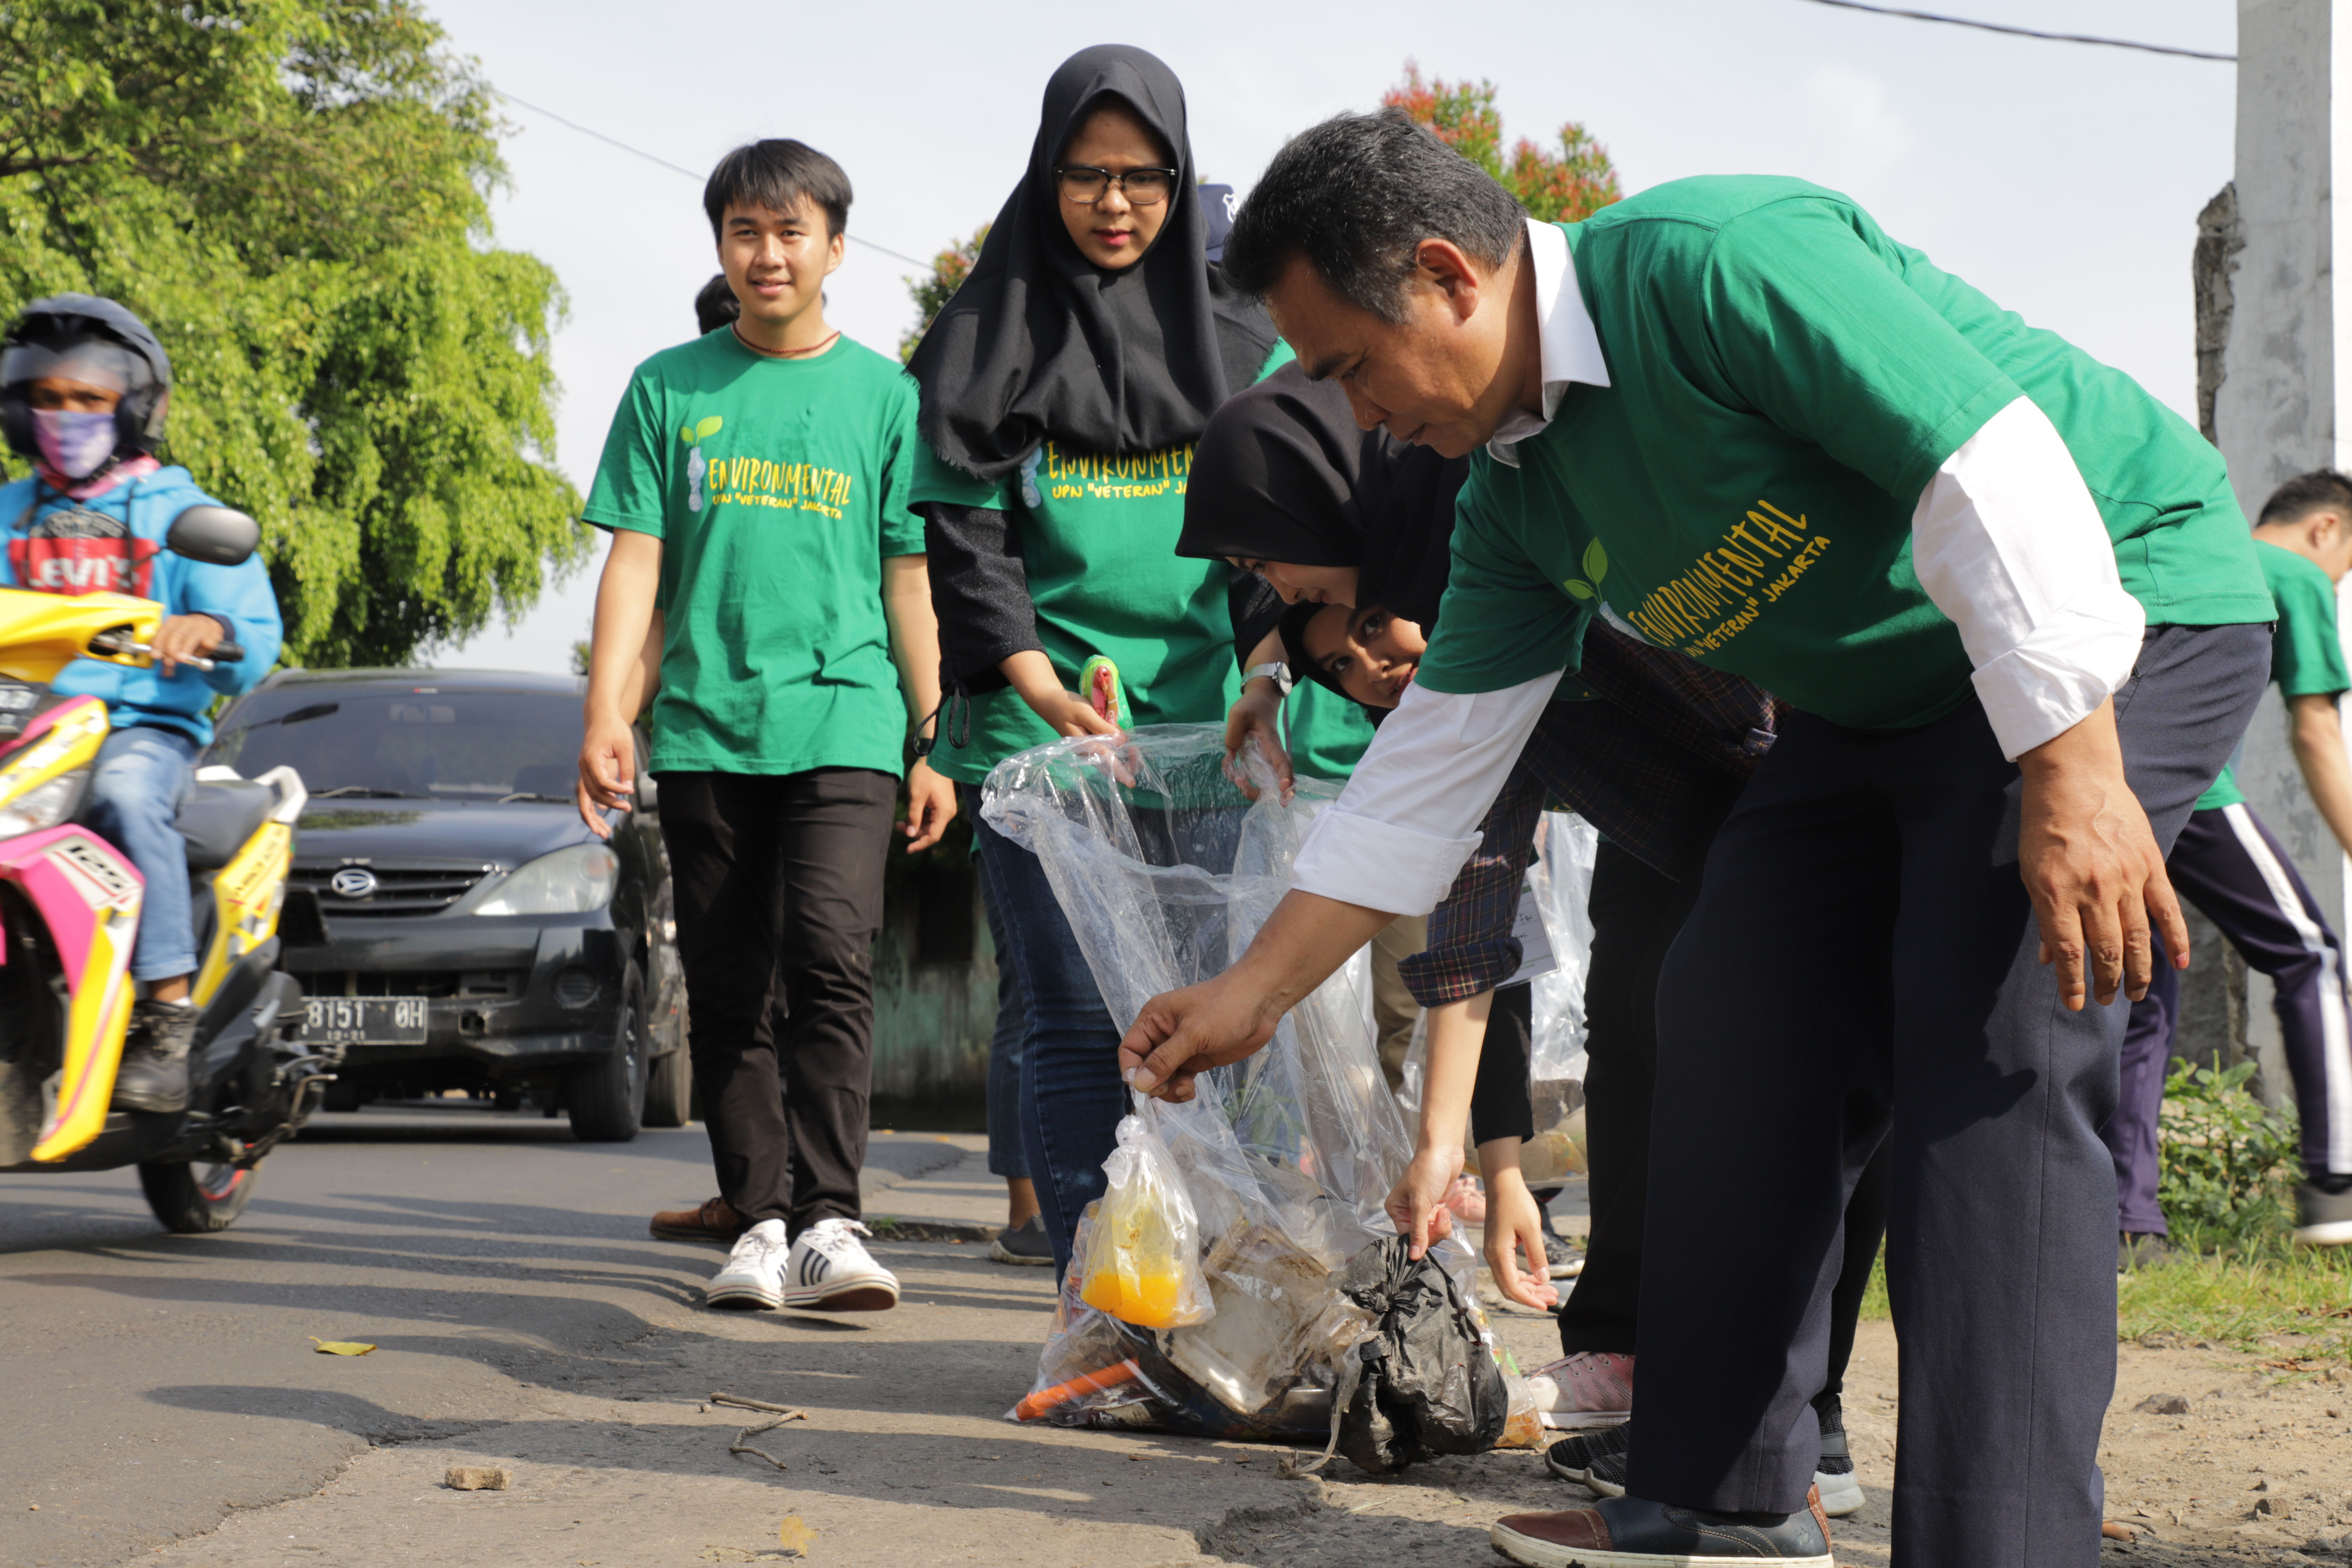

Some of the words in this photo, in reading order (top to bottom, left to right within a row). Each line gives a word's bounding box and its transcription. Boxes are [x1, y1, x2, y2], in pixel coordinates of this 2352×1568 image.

[708, 456, 851, 507] ENVIRONMENTAL
[735, 492, 798, 508] "VETERAN"
[1052, 484, 1083, 498] UPN
[1087, 479, 1170, 498] "VETERAN"
[1628, 499, 1807, 647] ENVIRONMENTAL
[1694, 597, 1759, 650] "VETERAN"
[1762, 536, 1831, 602] JAKARTA
[308, 1001, 364, 1028] 8151
